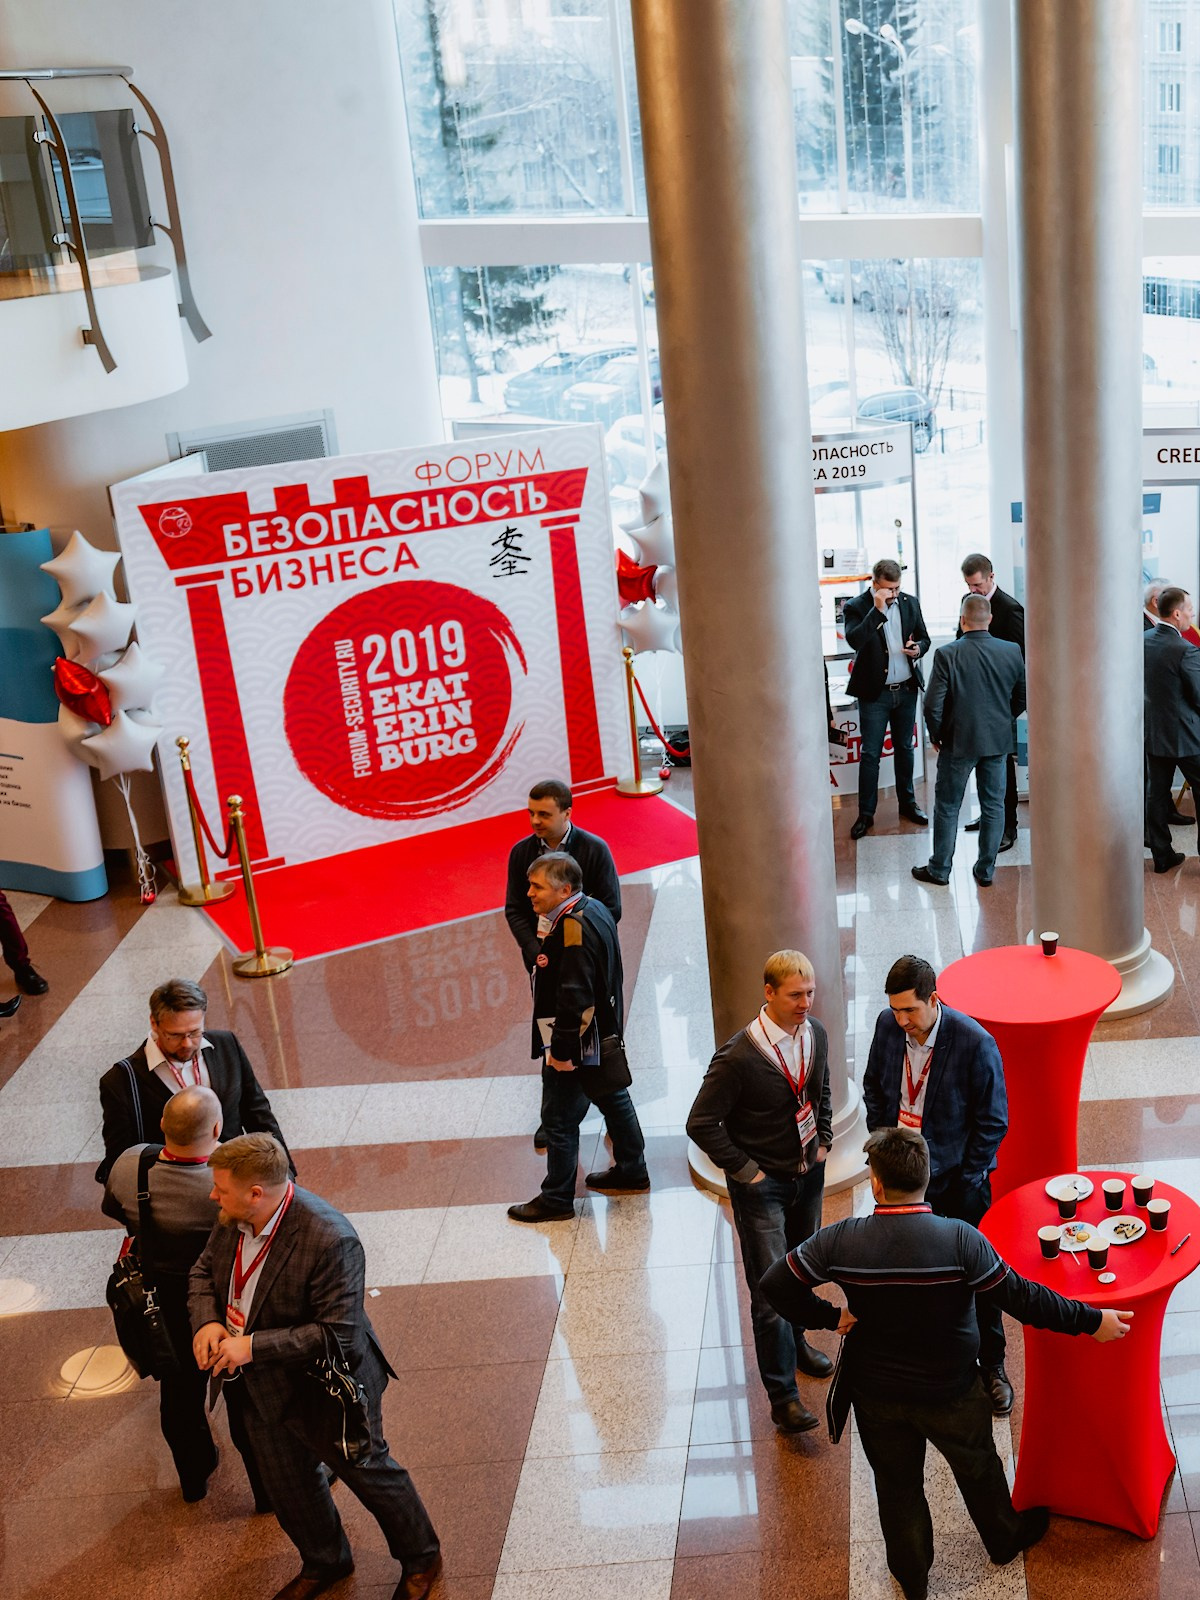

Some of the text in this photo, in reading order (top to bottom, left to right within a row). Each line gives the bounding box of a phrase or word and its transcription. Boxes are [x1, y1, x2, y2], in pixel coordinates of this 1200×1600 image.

[415, 447, 545, 487] ФОРУМ
[812, 441, 894, 461] ПАСНОСТЬ
[832, 464, 866, 479] 2019
[222, 481, 549, 558] БЕЗОПАСНОСТЬ
[231, 542, 420, 598] БИЗНЕСА
[362, 620, 467, 685] 2019
[333, 638, 373, 779] FORUM-SECURITY.RU
[369, 672, 470, 717] EKAT
[373, 700, 473, 745] ERIN
[377, 727, 478, 772] BURG
